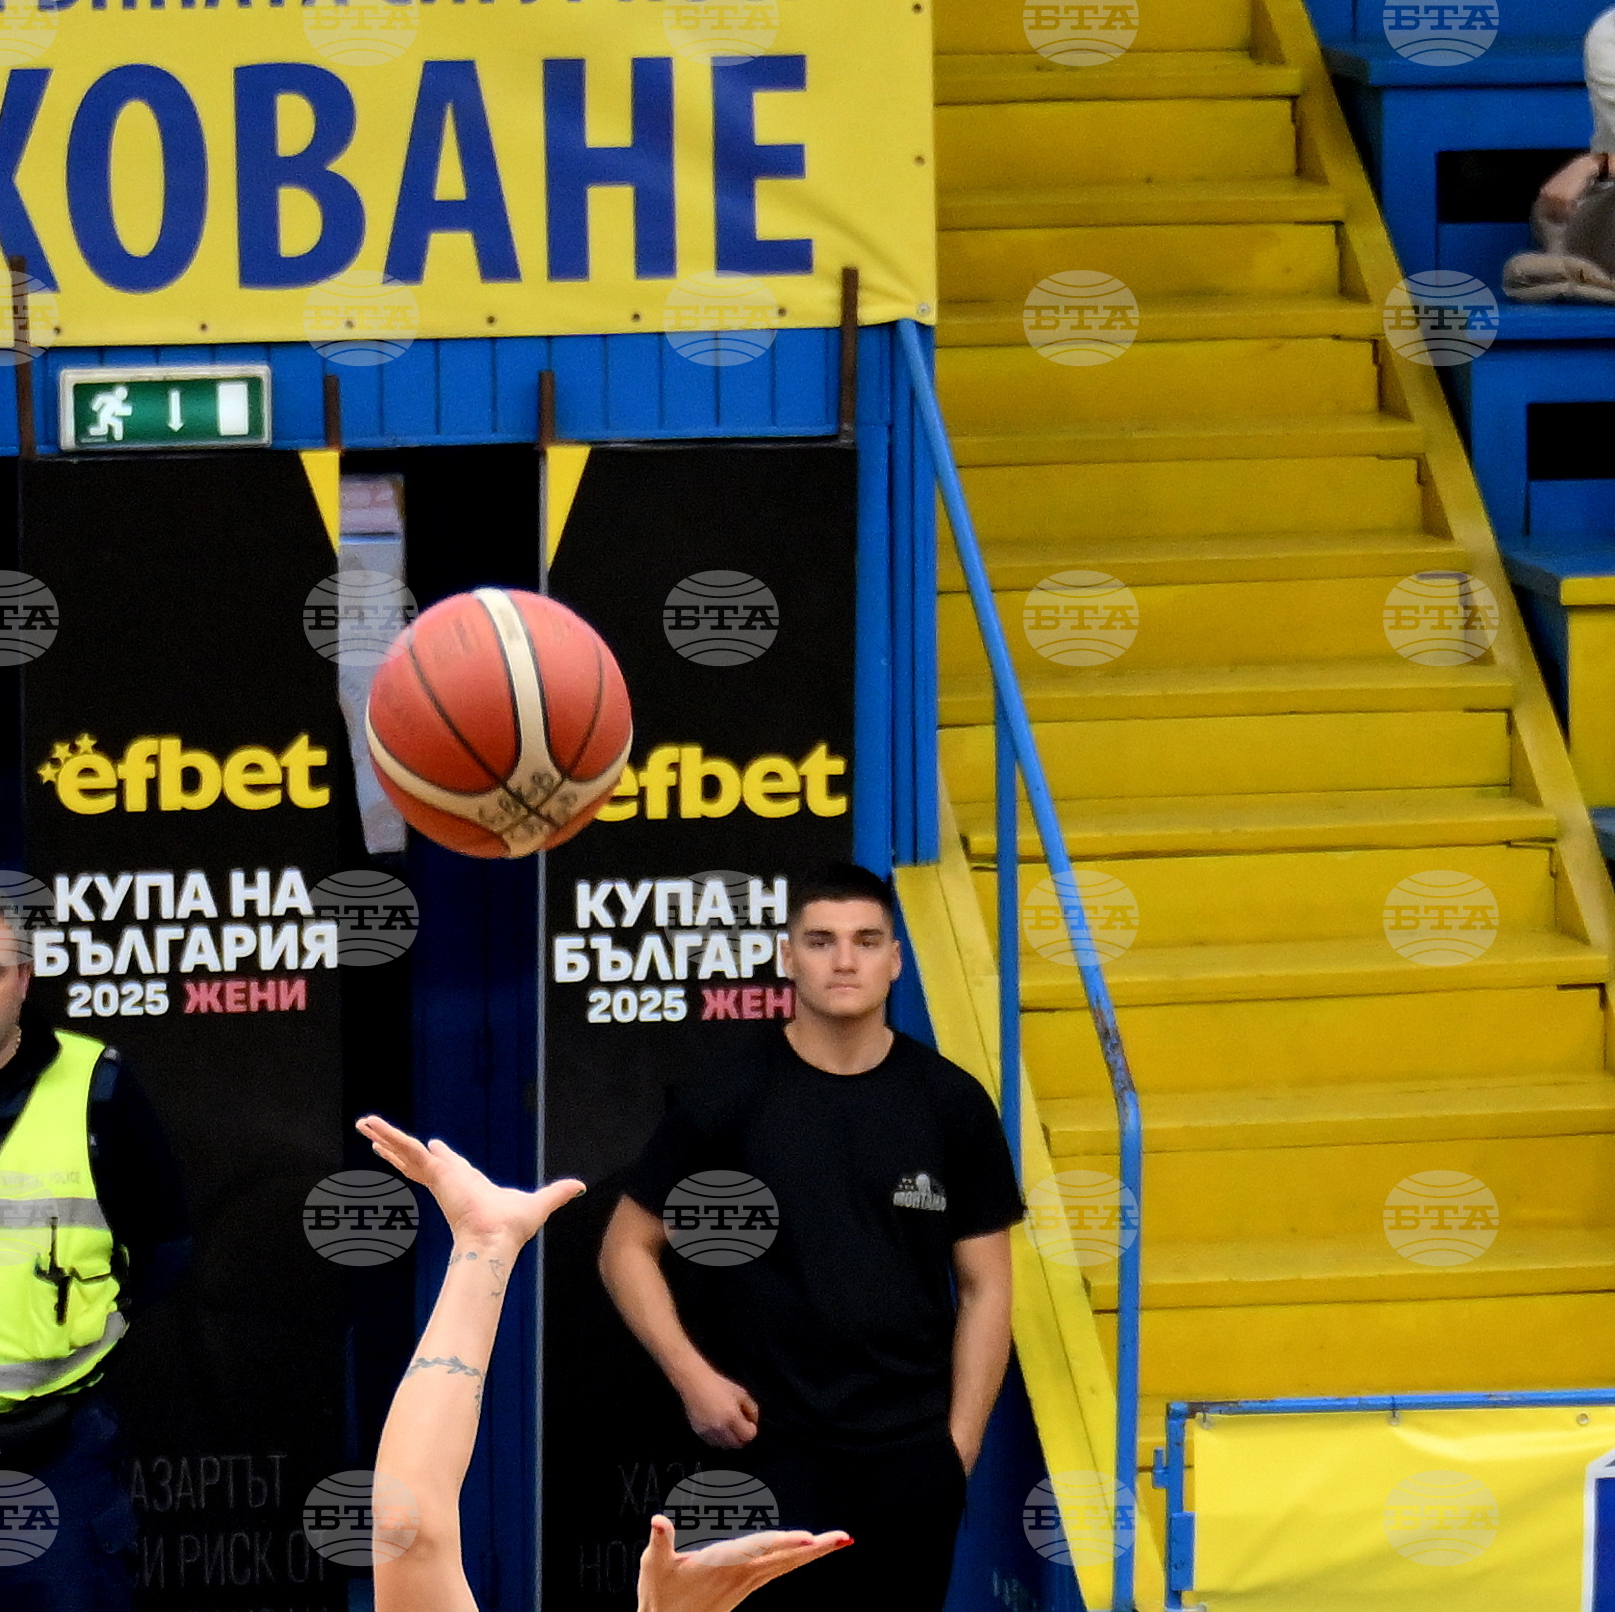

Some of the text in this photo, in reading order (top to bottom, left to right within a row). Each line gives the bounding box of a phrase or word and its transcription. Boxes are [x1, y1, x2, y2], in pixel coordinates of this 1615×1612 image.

[54, 733, 331, 814] efbet
[53, 867, 314, 923] КУПА НА
[576, 876, 787, 929] КУПА Н
[33, 922, 339, 978] БЪЛГАРИЯ
[553, 932, 789, 985] БЪЛГАР
[66, 977, 307, 1018] 2025 ЖЕНИ
[587, 986, 797, 1024] 2025 ЖЕН
[130, 1454, 287, 1512] АЗАРТЪТ
[179, 1531, 277, 1588] РИСК
